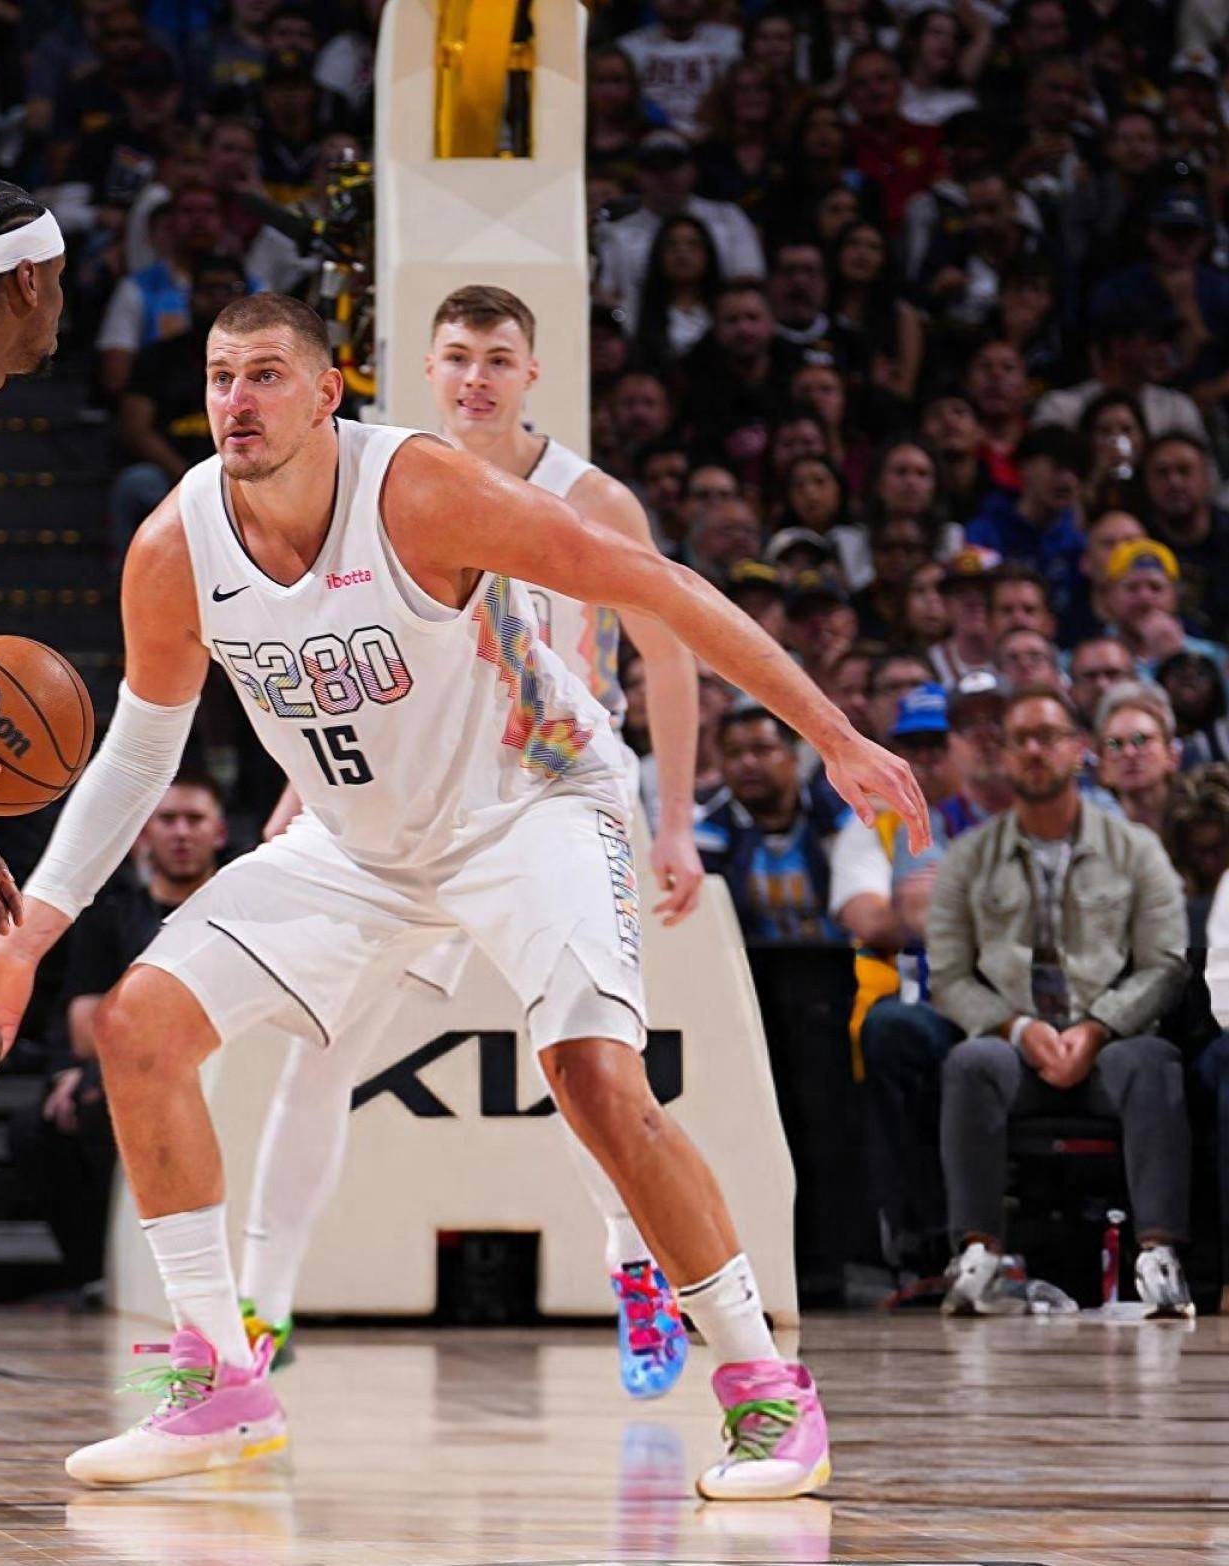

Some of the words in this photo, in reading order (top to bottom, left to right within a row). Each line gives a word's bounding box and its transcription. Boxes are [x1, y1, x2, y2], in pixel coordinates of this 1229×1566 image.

[326, 569, 372, 590] ibotta
[213, 625, 413, 718] 5280
[301, 725, 374, 786] 15
